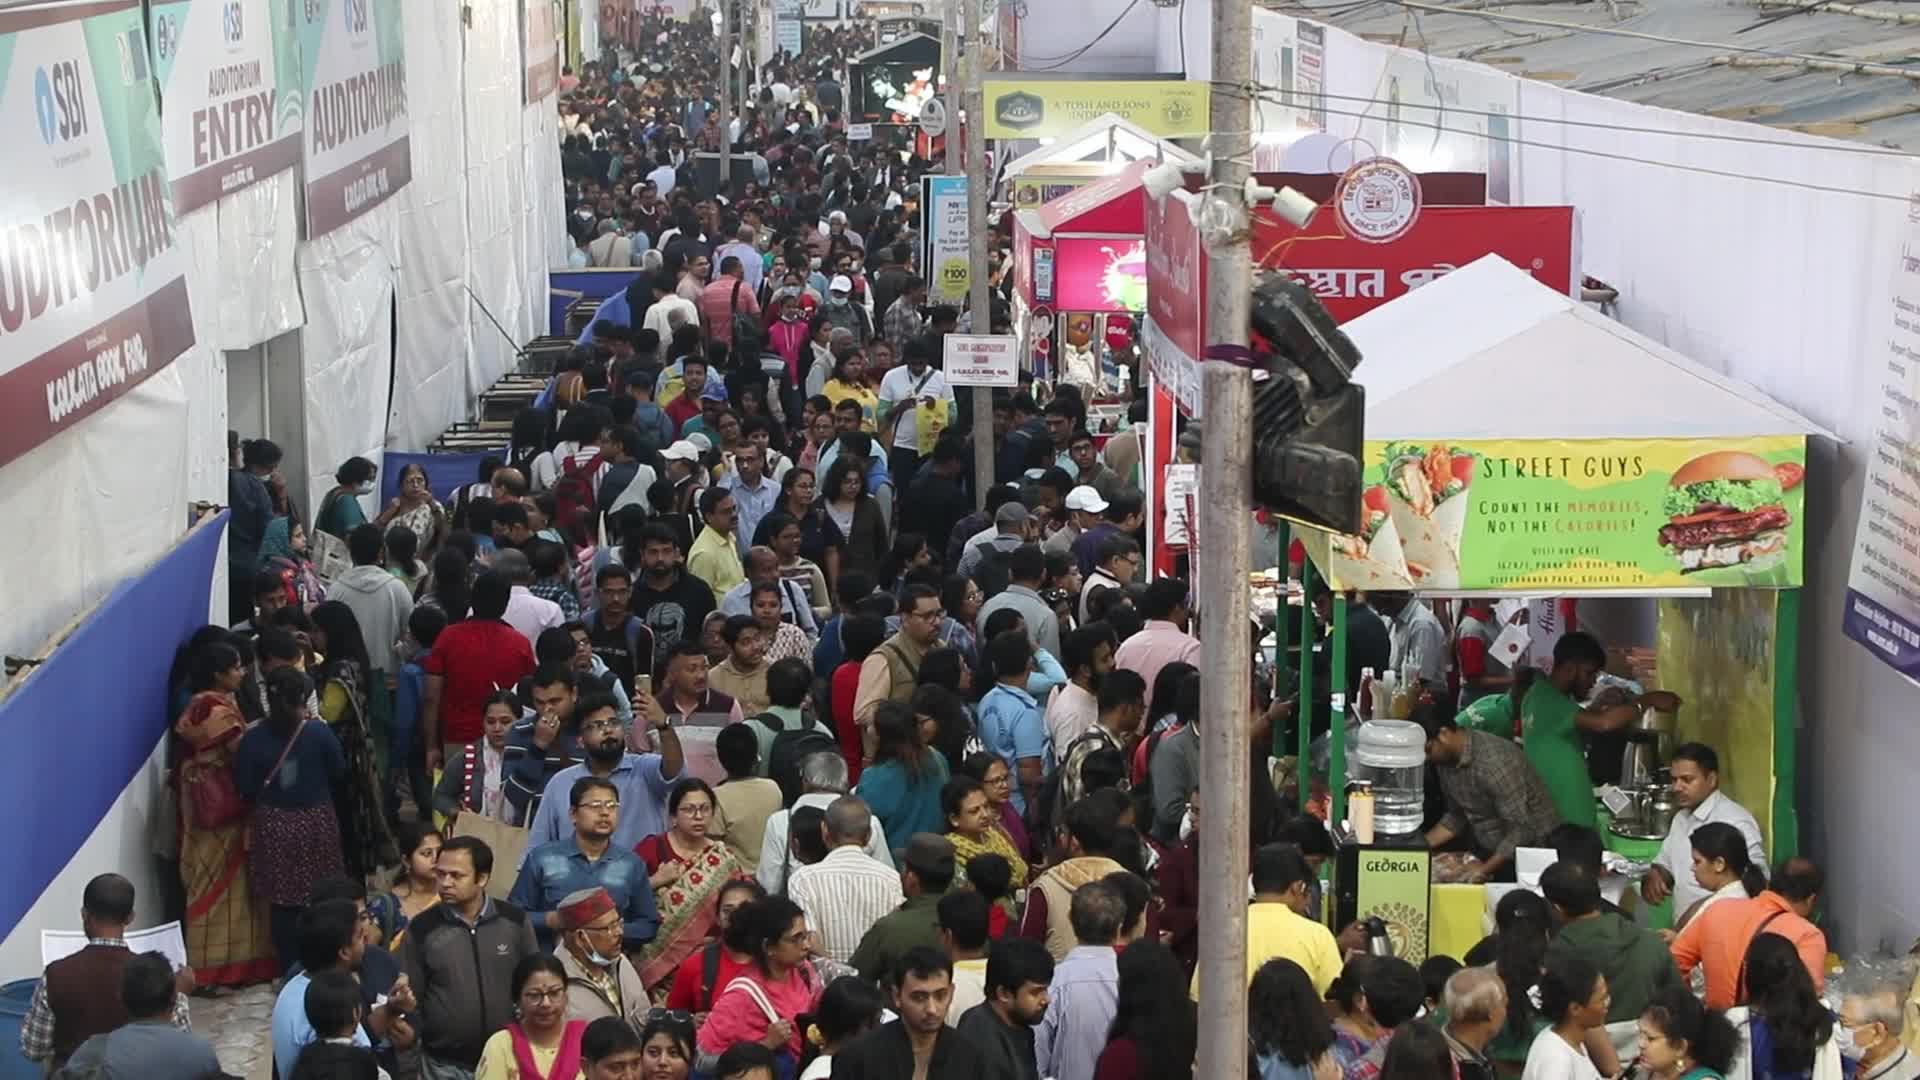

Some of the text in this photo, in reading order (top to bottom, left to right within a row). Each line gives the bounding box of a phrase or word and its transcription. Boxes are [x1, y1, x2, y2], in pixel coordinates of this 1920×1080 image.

[209, 59, 262, 98] AUDITORIUM
[53, 59, 88, 141] SBI
[1095, 100, 1121, 110] AND
[1122, 100, 1151, 110] SONS
[193, 88, 276, 167] ENTRY
[0, 168, 171, 333] UDITORIUM
[46, 360, 98, 423] KOLKATA
[1483, 456, 1643, 479] STREET GUYS
[1479, 500, 1528, 516] COUNT
[1536, 501, 1560, 513] THE
[1487, 520, 1515, 534] NOT
[1524, 520, 1547, 533] THE
